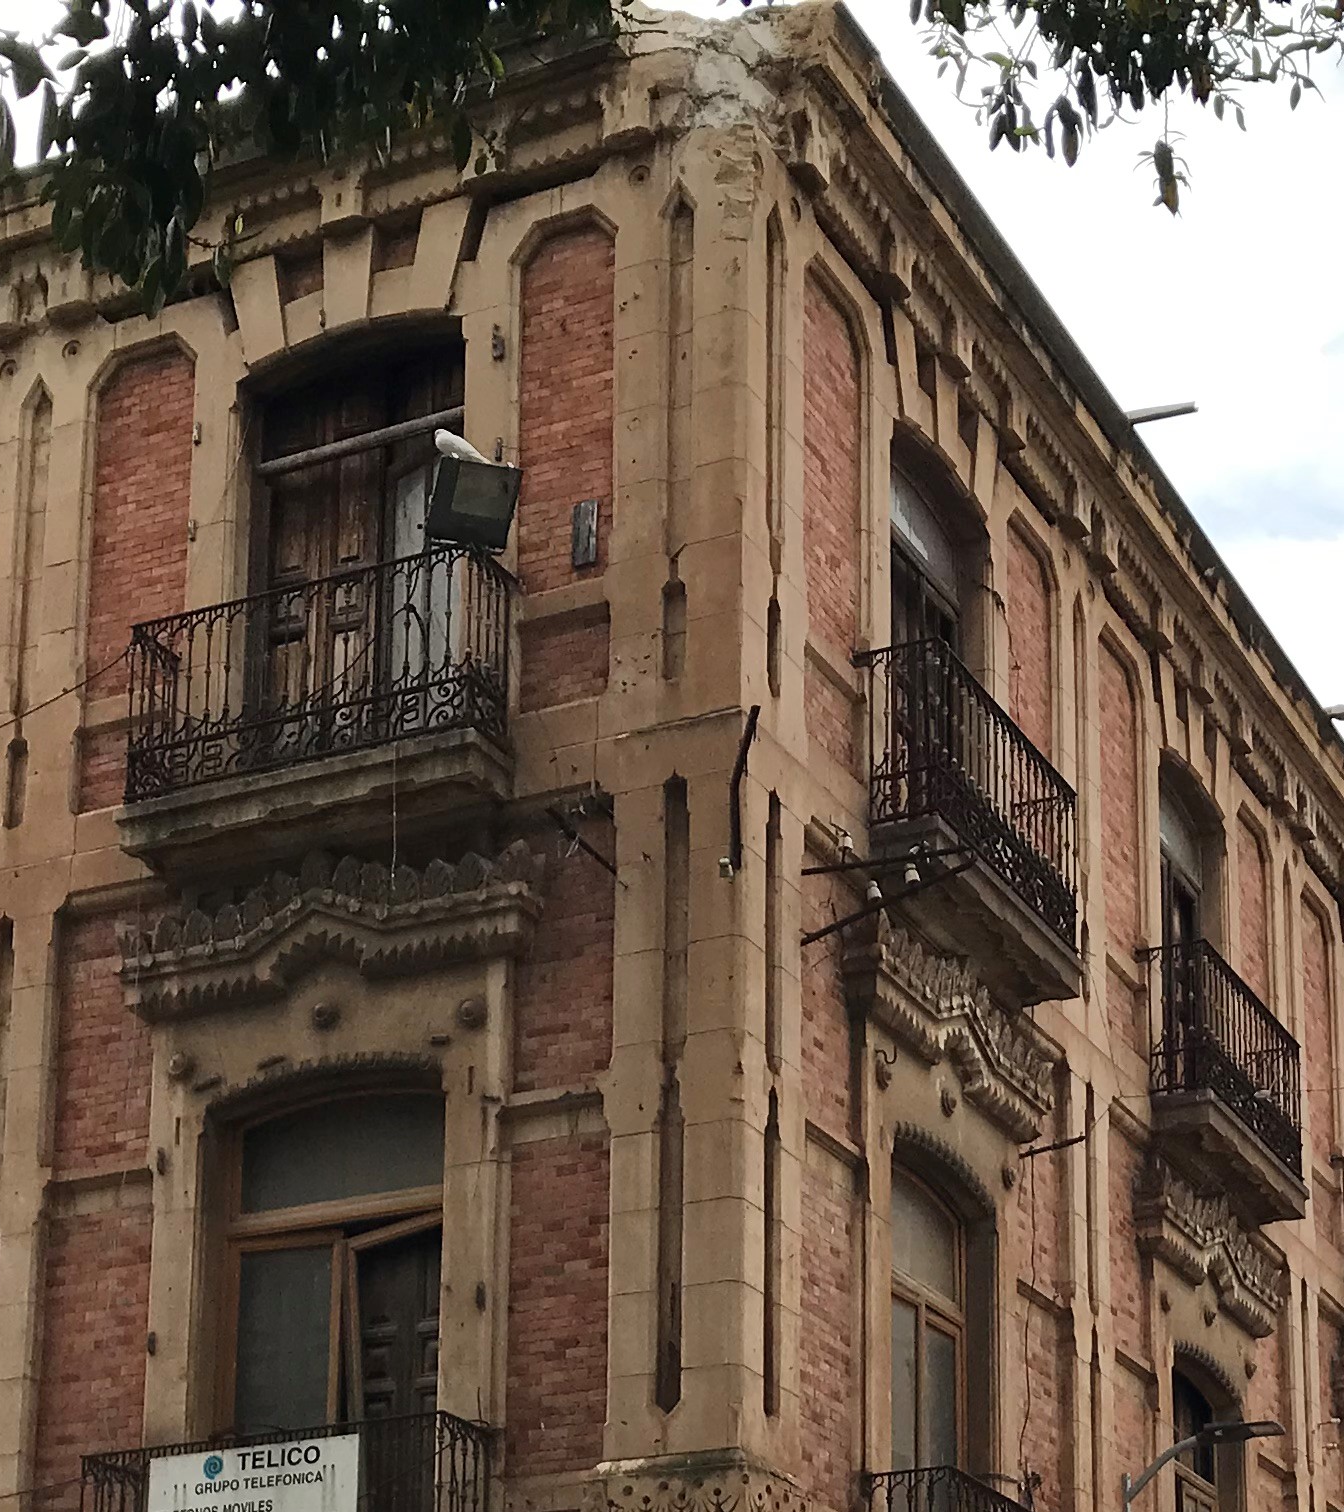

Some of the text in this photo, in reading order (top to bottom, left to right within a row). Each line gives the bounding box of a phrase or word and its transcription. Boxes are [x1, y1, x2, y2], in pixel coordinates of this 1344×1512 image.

[237, 1445, 321, 1471] TELICO
[194, 1470, 323, 1495] GRUPO TELEFONICA
